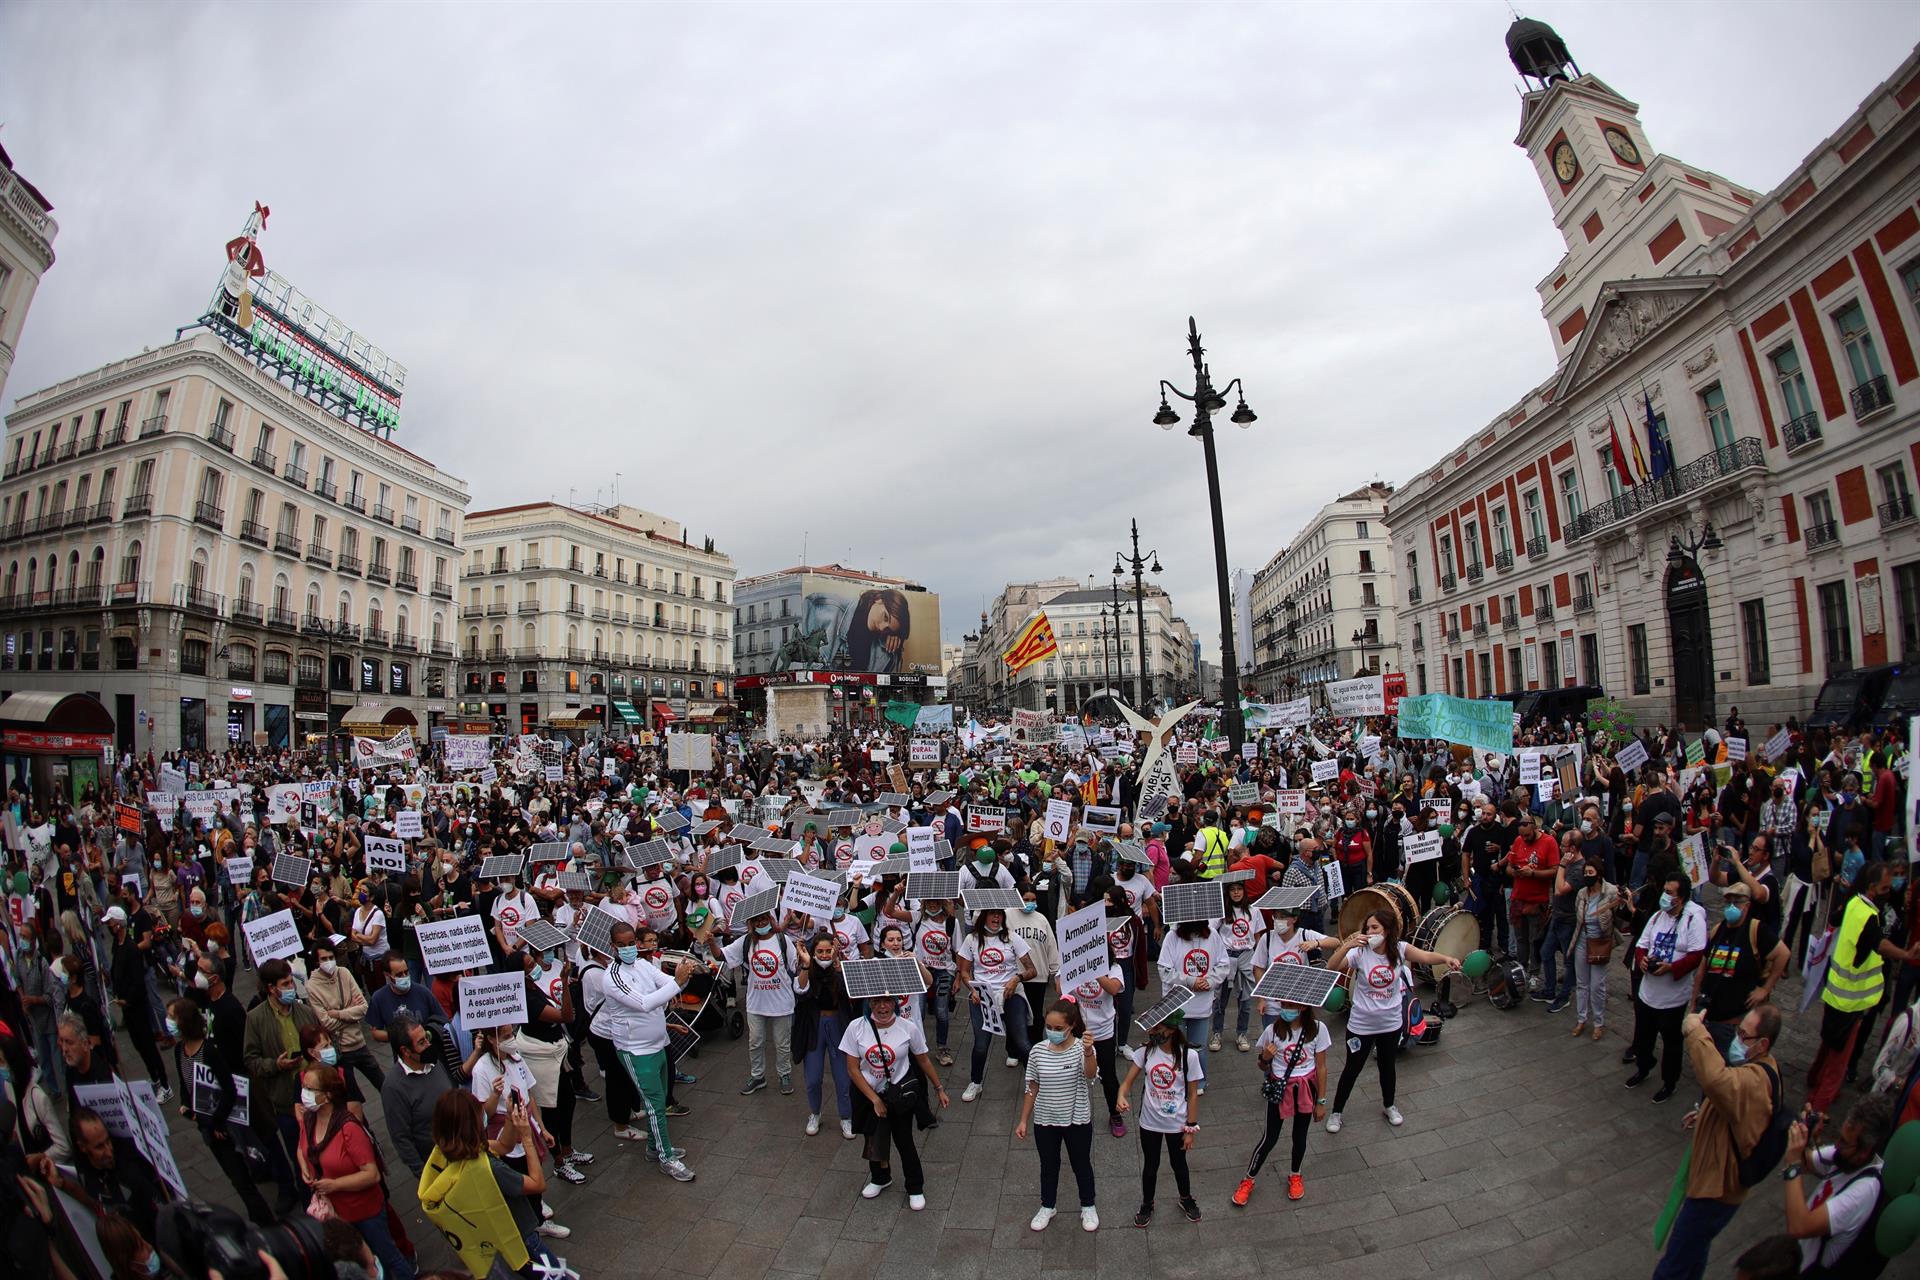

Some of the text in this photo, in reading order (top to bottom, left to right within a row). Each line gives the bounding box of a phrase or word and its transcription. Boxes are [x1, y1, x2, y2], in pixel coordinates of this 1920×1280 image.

[325, 314, 408, 388] PEPE
[1388, 685, 1402, 696] NO
[401, 748, 415, 759] NO
[152, 793, 168, 803] ANTE
[1421, 799, 1451, 807] TERUEL
[968, 805, 1005, 817] TERUEL
[911, 833, 931, 842] Armonizar
[1417, 834, 1426, 842] NO
[1411, 839, 1440, 850] COLONIALISMO
[370, 856, 403, 869] NO!
[789, 878, 800, 888] Las
[795, 888, 812, 899] escala
[793, 895, 802, 904] del
[802, 898, 815, 908] gran
[814, 899, 833, 911] capital.
[449, 926, 464, 937] nada
[1064, 916, 1099, 943] Armonizar
[254, 947, 265, 959] más
[267, 940, 283, 955] nuestro
[452, 940, 463, 951] bien
[1061, 935, 1106, 965] las renovables
[463, 954, 475, 964] muy
[1066, 955, 1105, 982] con su lugar.
[464, 981, 523, 997] Las renovables, ya:
[468, 1000, 474, 1008] A
[474, 996, 495, 1007] escala
[466, 1003, 524, 1020] no del gran capital.
